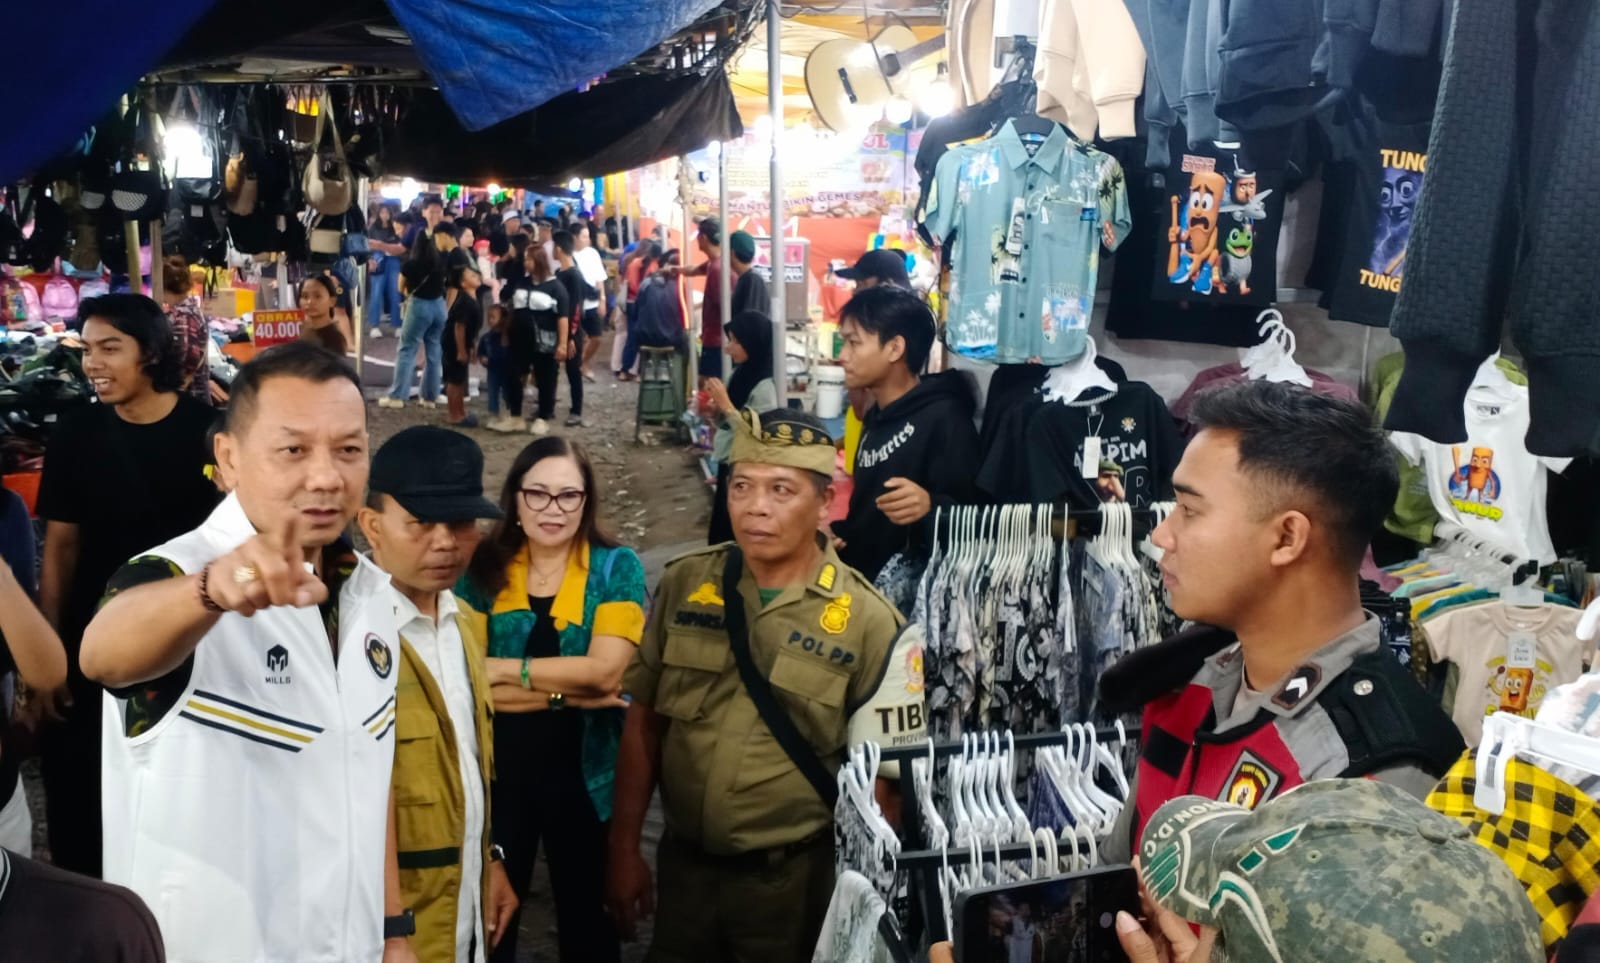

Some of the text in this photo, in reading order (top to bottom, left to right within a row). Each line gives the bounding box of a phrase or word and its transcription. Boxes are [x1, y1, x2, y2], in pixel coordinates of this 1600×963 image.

[255, 313, 301, 322] OBRAL
[788, 630, 855, 665] POL PP
[265, 676, 291, 685] MILLS
